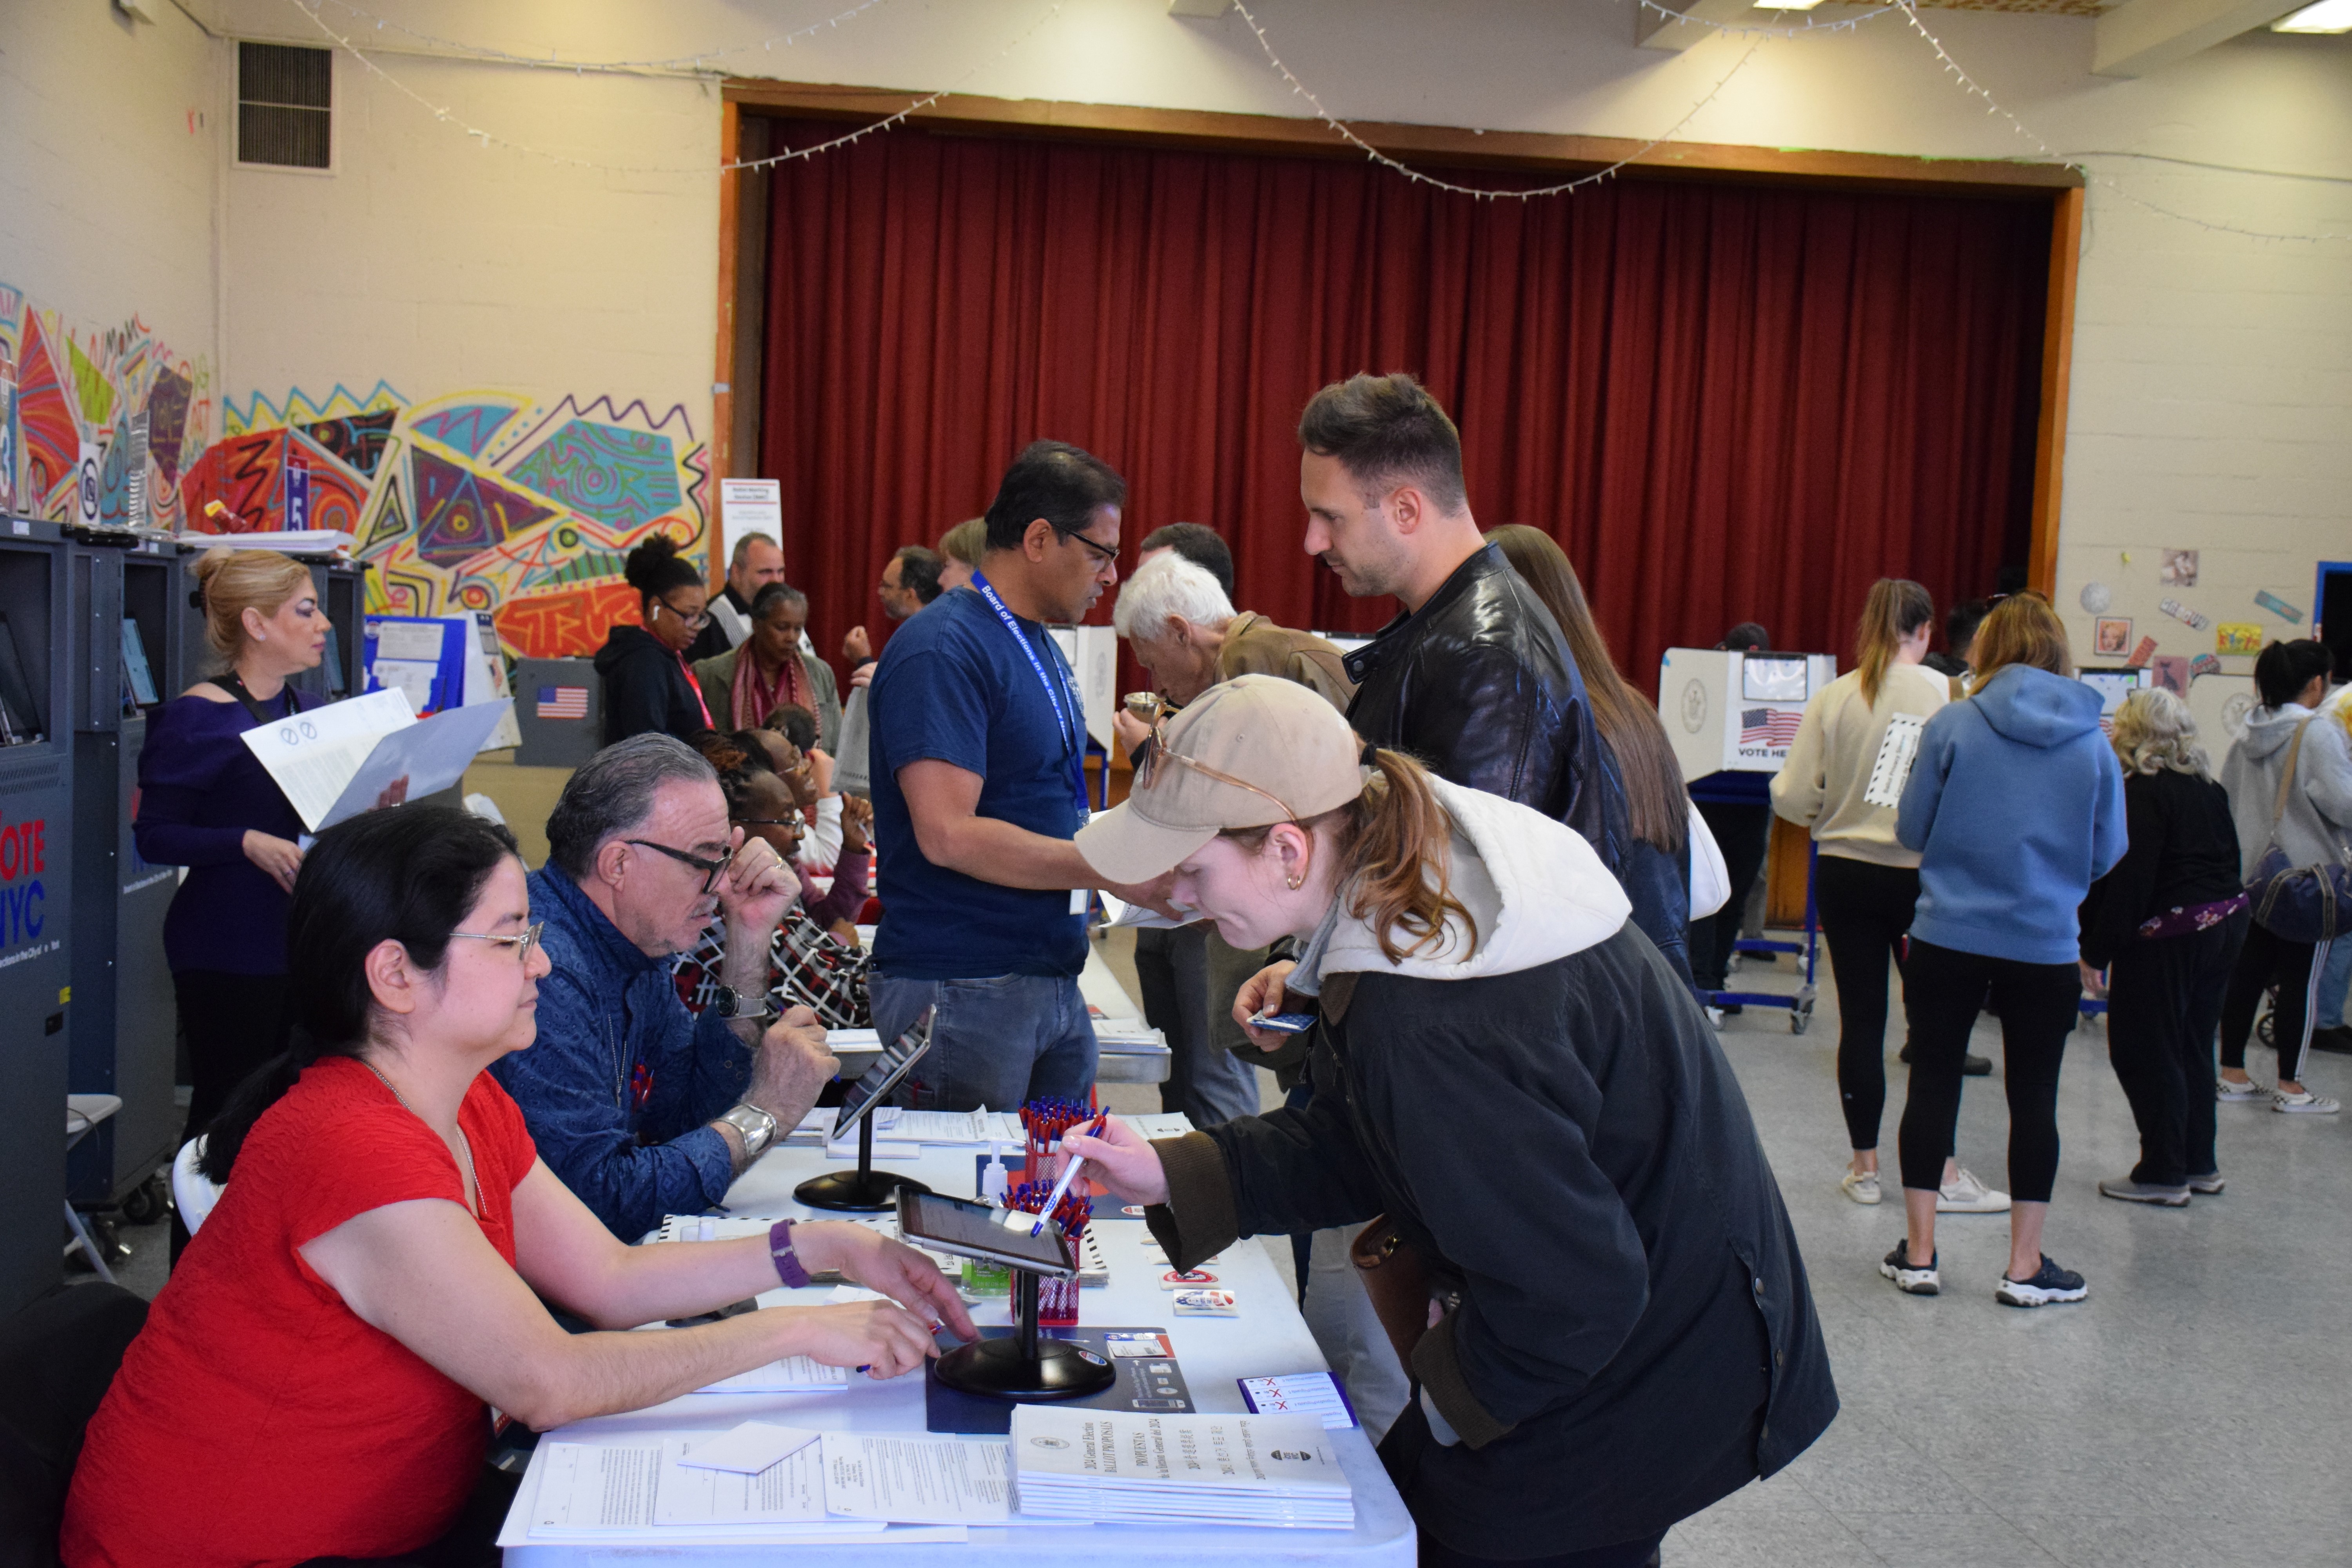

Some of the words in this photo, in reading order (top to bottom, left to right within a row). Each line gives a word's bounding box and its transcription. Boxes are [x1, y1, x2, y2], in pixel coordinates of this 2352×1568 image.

[982, 585, 1005, 611] Board
[1000, 612, 1013, 620] of
[1007, 621, 1035, 661] Elections
[1033, 662, 1042, 671] in
[1040, 672, 1049, 687] the
[1048, 689, 1058, 707] City
[1056, 709, 1063, 719] of
[1739, 748, 1768, 757] VOTE
[1772, 749, 1787, 758] HE
[0, 818, 44, 881] OTE
[1082, 1422, 1094, 1441] Election
[1148, 1418, 1161, 1428] 2024
[1100, 1421, 1115, 1452] PROPOSALS
[1151, 1436, 1165, 1454] General
[1083, 1441, 1096, 1459] General
[1132, 1432, 1149, 1466] PROPUESTAS
[1103, 1452, 1117, 1473] BALLOT
